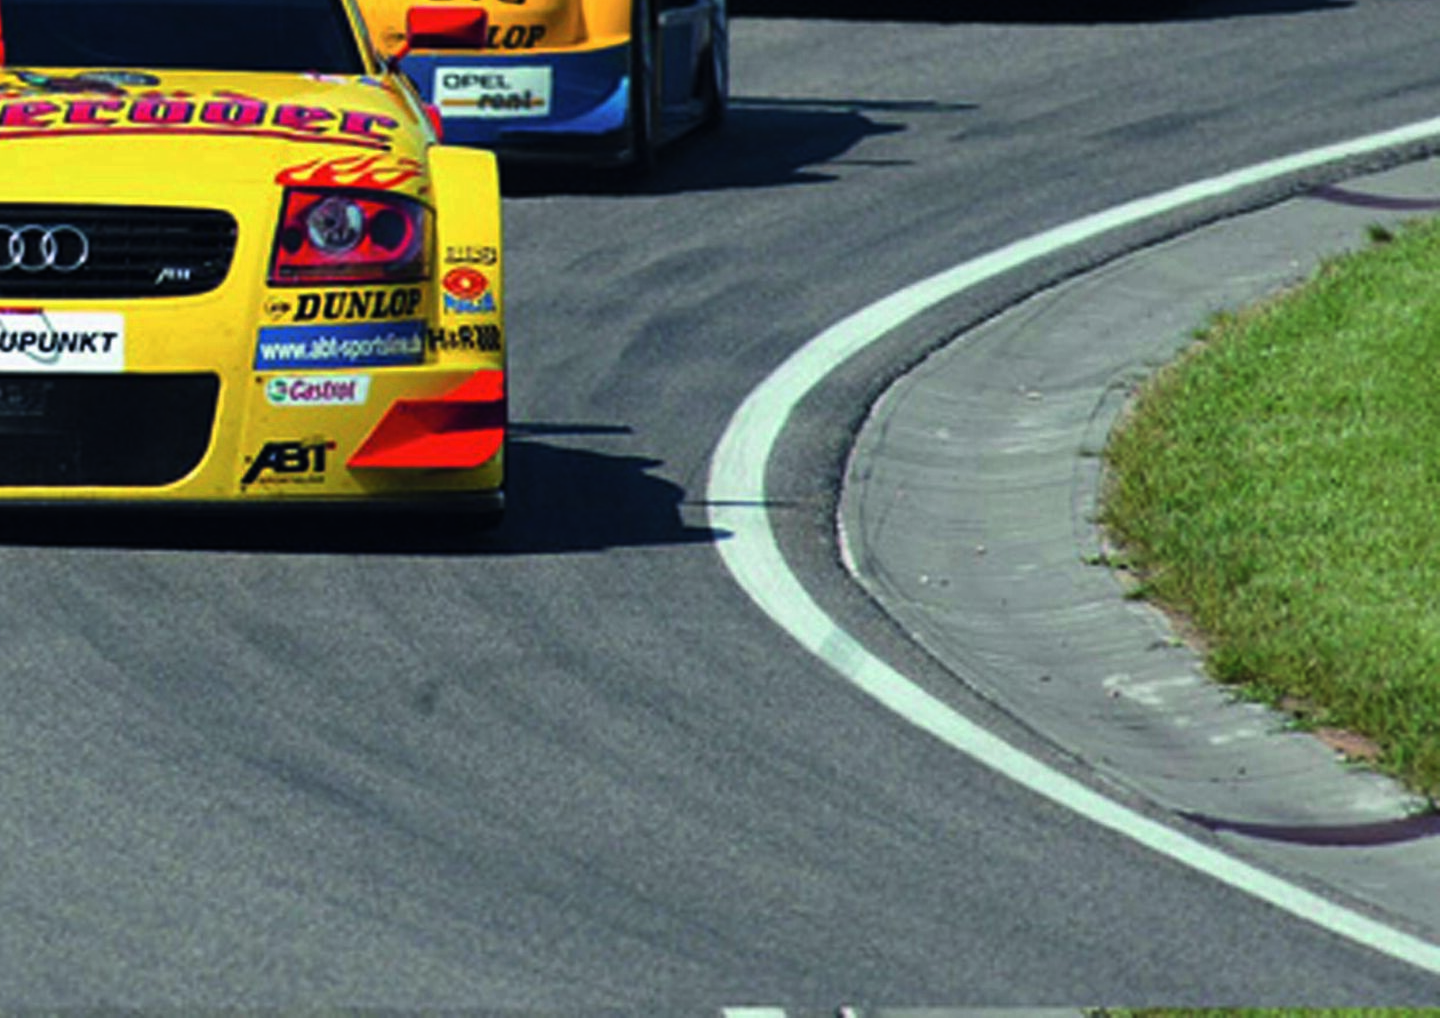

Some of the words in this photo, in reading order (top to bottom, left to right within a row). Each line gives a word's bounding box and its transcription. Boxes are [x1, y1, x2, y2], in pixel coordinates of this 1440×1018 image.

[486, 25, 547, 50] LOP
[442, 73, 512, 90] OPEL
[293, 288, 421, 322] DUNLOP
[289, 380, 356, 401] Castrol
[241, 441, 337, 484] ABT
